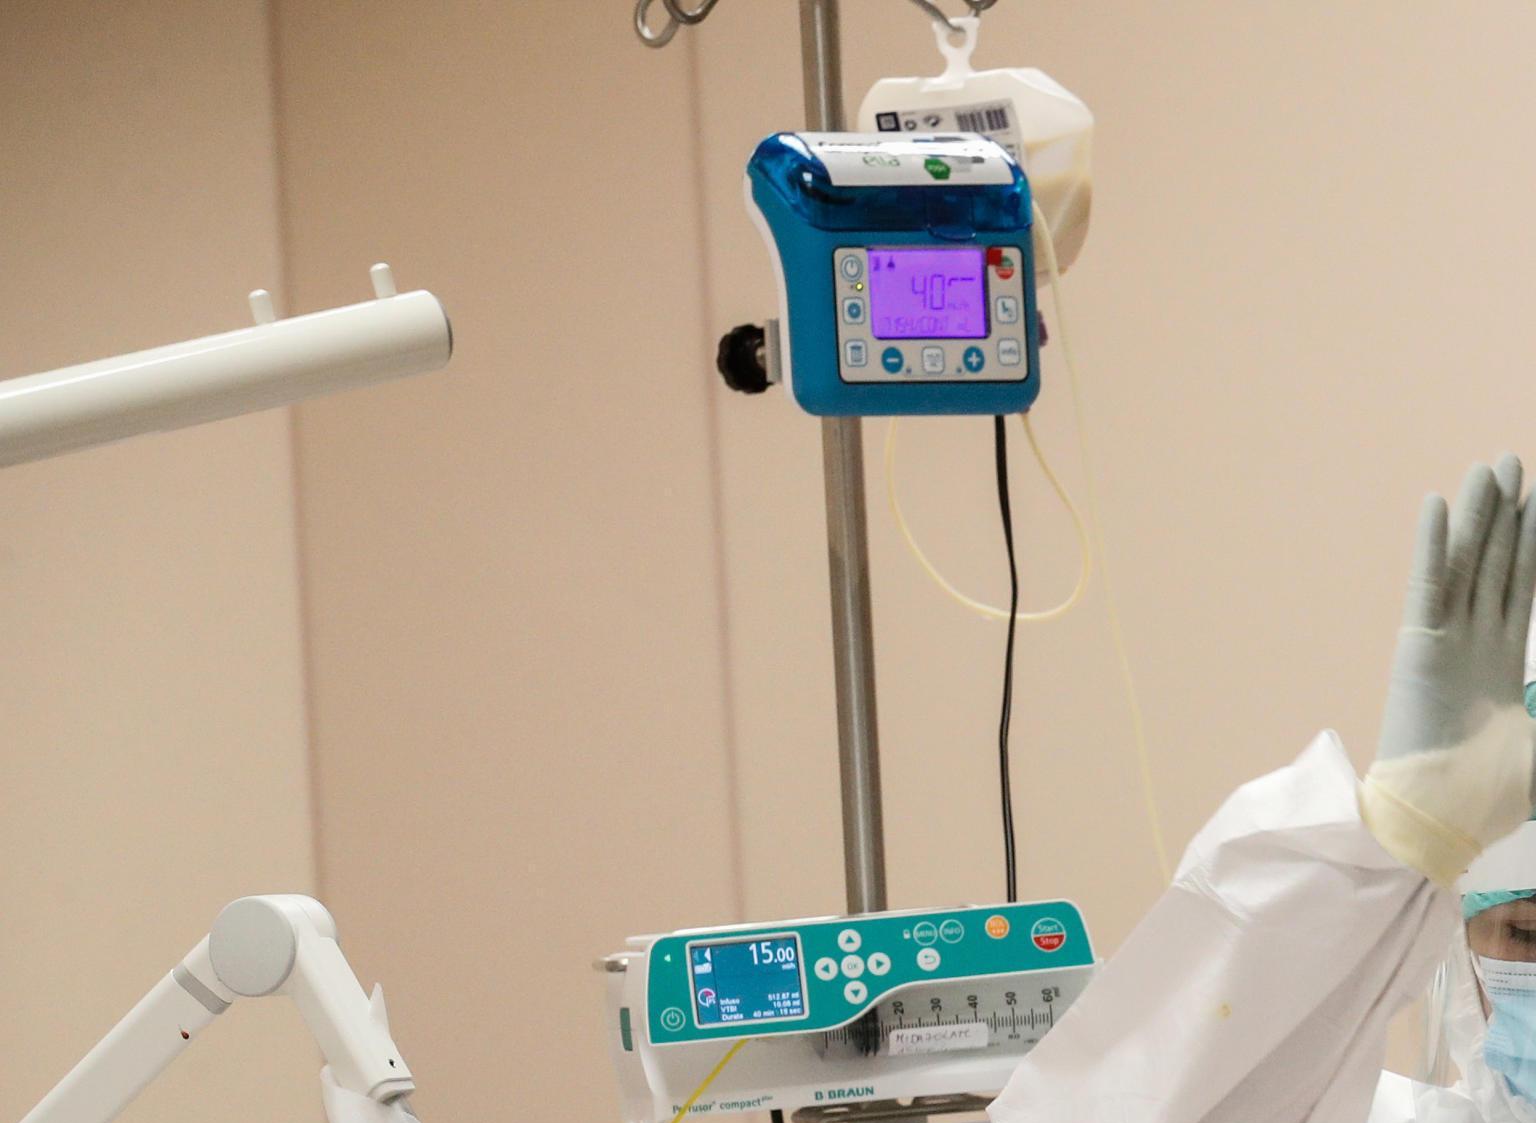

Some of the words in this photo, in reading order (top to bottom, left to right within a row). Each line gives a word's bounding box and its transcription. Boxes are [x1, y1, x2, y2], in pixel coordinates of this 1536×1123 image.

[1037, 924, 1059, 934] Start
[1040, 936, 1060, 947] Stop
[748, 941, 795, 966] 15.00
[893, 1001, 905, 1016] 20
[930, 997, 943, 1012] 30
[967, 994, 979, 1009] 40
[1005, 991, 1017, 1006] 50
[1041, 988, 1053, 1003] 60
[720, 1005, 737, 1013] VTBI
[827, 1085, 875, 1100] BRAUN
